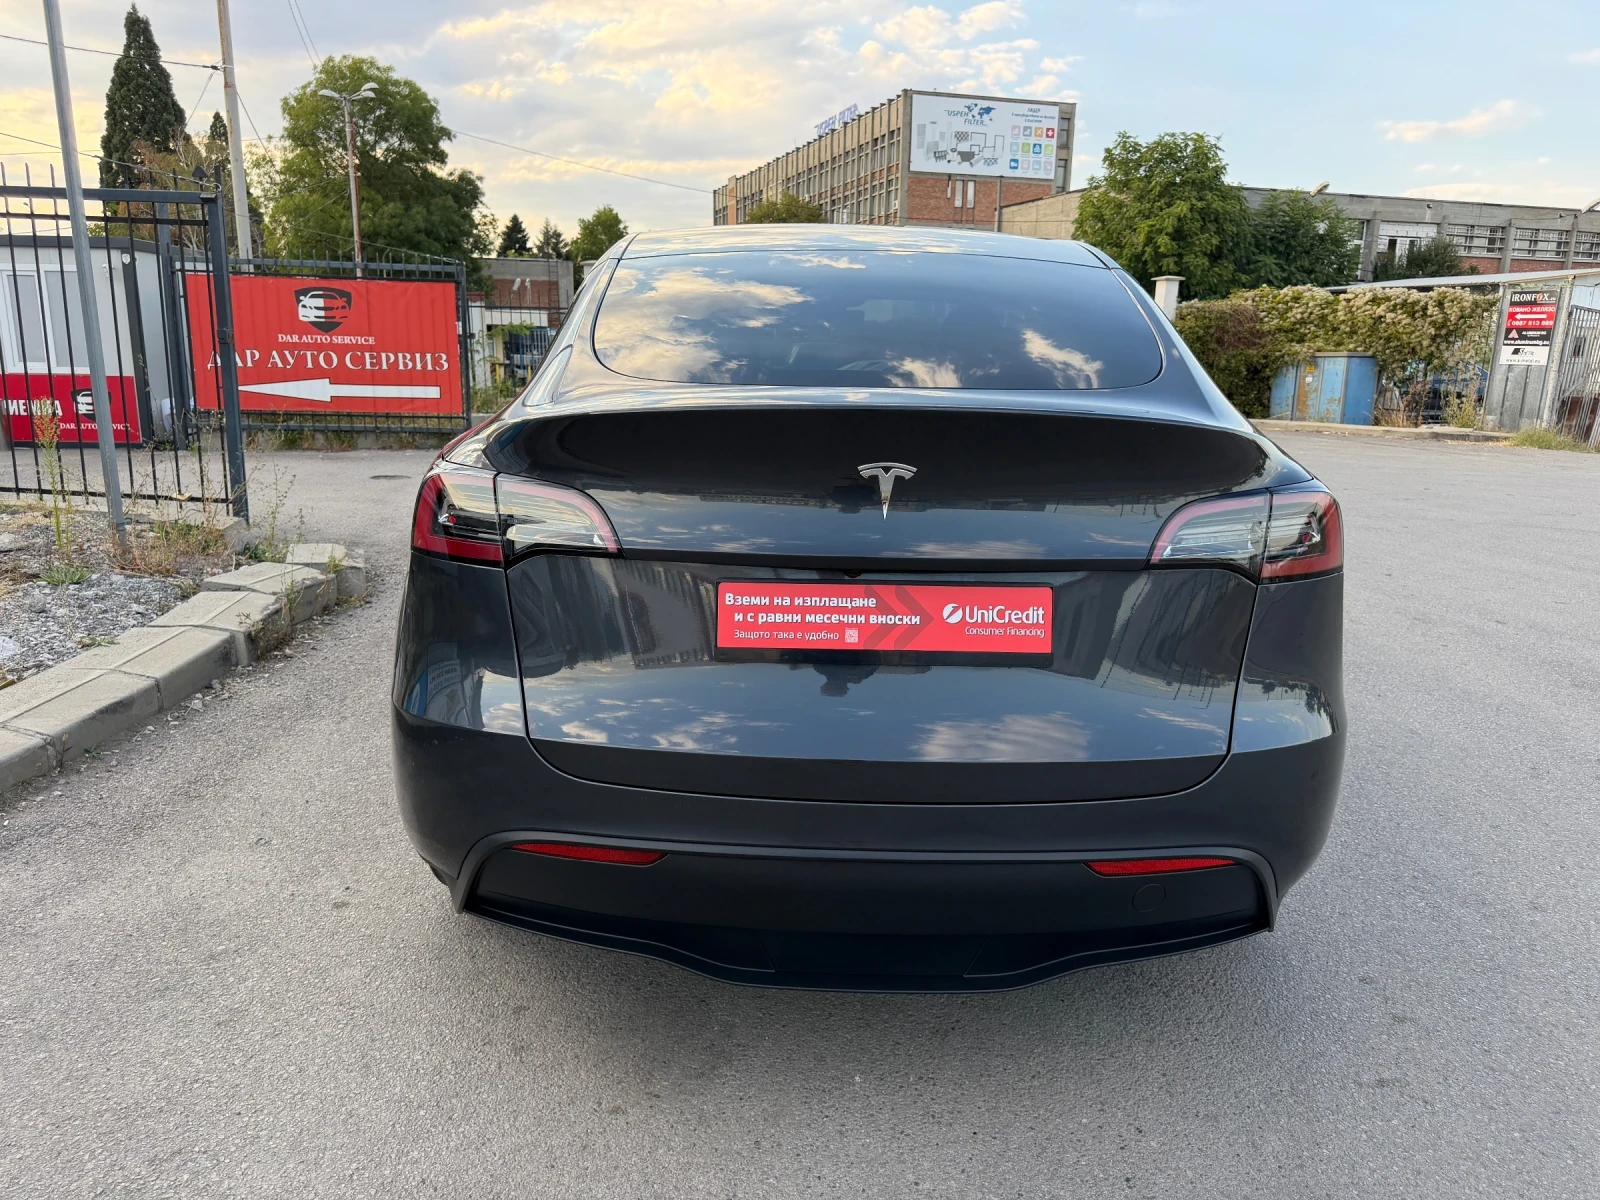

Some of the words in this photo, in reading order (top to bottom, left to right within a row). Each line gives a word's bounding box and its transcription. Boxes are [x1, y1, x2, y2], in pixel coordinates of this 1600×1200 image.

[278, 333, 301, 343] DAR
[301, 334, 330, 344] AUTO
[332, 335, 375, 345] SERVICE
[267, 350, 338, 369] АУТО
[345, 351, 449, 371] СЕРВИЗ
[60, 422, 76, 430] DAR
[725, 593, 770, 606] Вземи
[774, 595, 791, 606] на
[794, 596, 877, 609] изплащане
[734, 613, 743, 622] и
[747, 613, 755, 622] с
[758, 613, 801, 625] равни
[805, 614, 866, 624] месечни
[869, 615, 921, 625] вноски
[965, 605, 1045, 624] UniCredit
[733, 629, 770, 641] Защото
[773, 631, 795, 640] така
[797, 631, 803, 640] е
[805, 629, 839, 641] удобно
[965, 626, 1005, 636] Consumer
[1007, 626, 1045, 638] Financing
